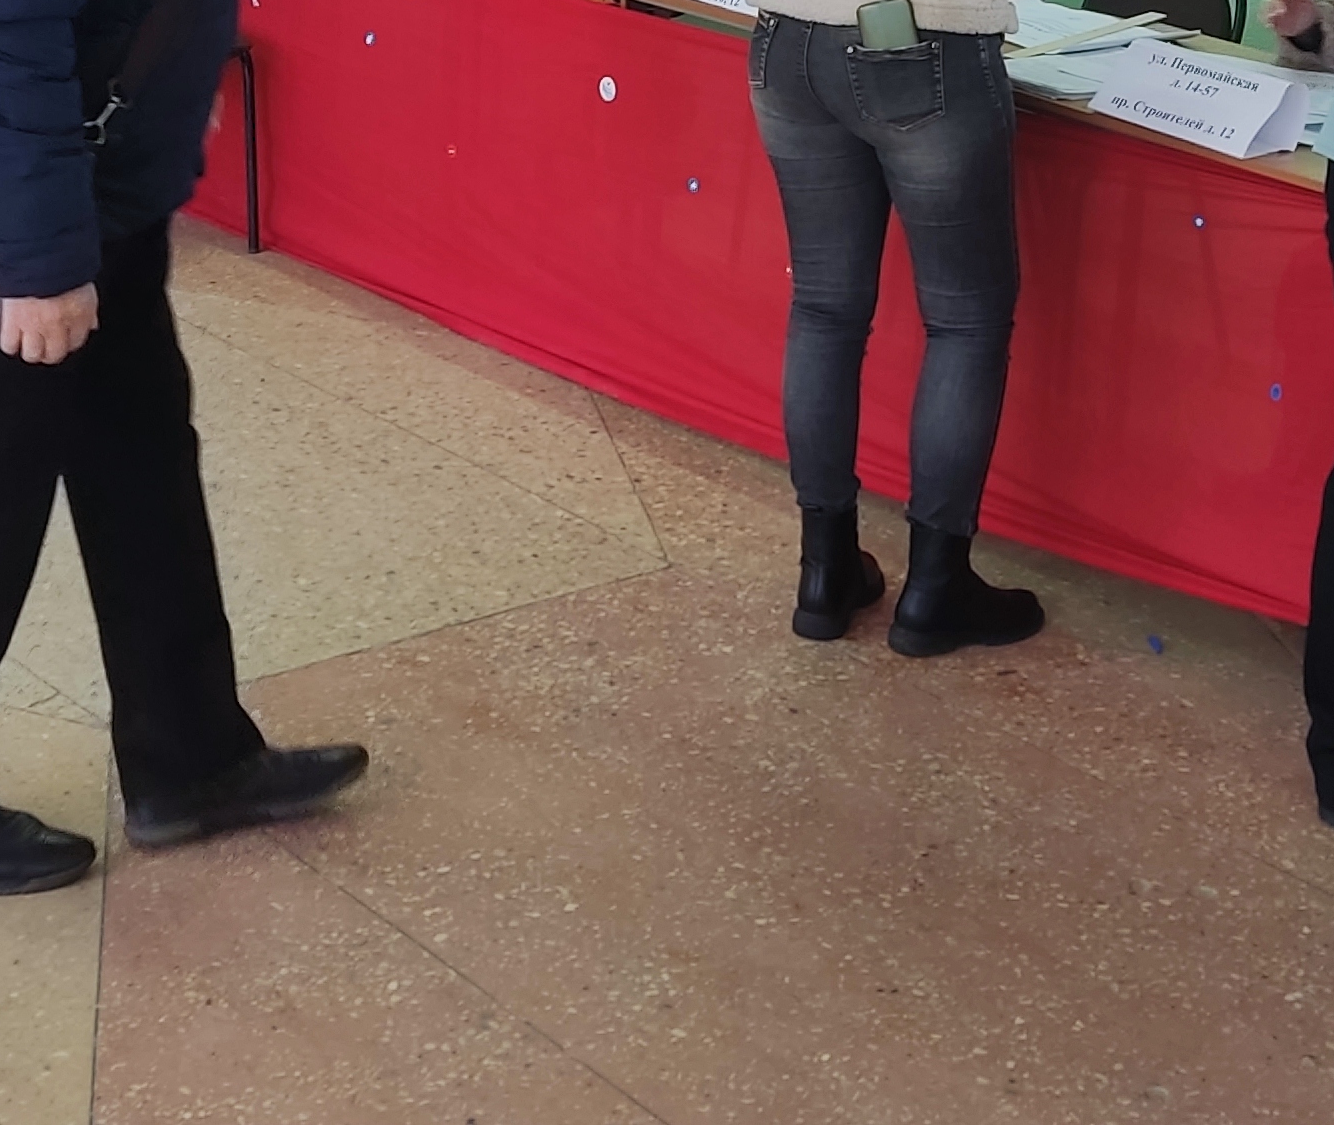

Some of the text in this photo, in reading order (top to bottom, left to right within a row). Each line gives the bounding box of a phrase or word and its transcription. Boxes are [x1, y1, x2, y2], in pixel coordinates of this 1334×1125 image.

[1148, 53, 1260, 93] ул. Первомайская
[1185, 80, 1220, 98] 14-57
[1110, 95, 1130, 110] пр.
[1133, 99, 1206, 131] Строителей
[1218, 125, 1237, 140] 12
